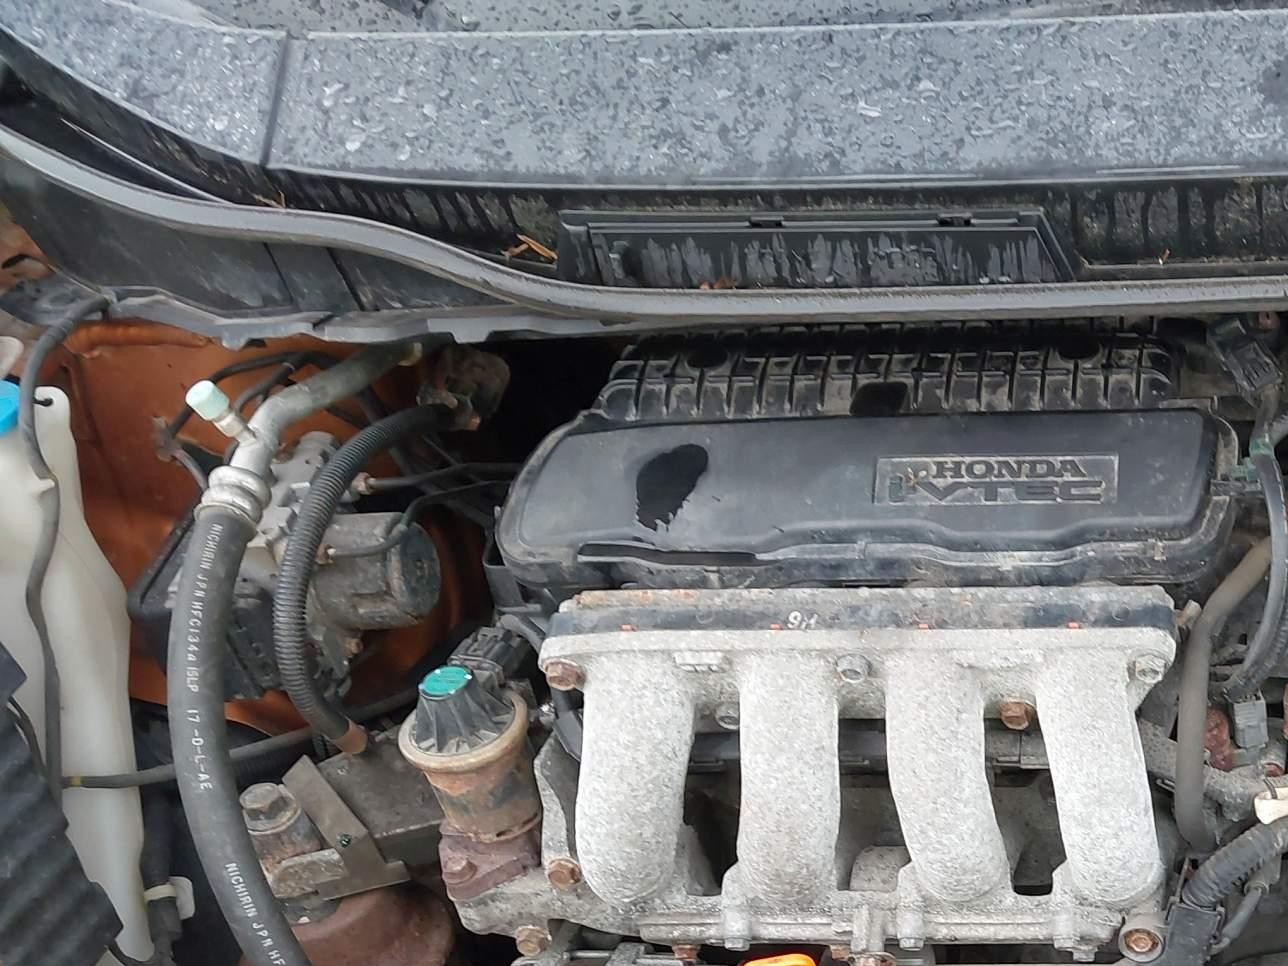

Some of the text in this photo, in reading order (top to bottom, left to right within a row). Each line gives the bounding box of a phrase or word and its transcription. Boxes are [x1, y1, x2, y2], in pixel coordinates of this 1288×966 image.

[931, 459, 1088, 480] HONDA
[200, 523, 224, 570] NICHIRIN
[193, 573, 209, 598] JPN
[225, 862, 258, 917] NICHIRIN
[252, 922, 273, 947] JPN
